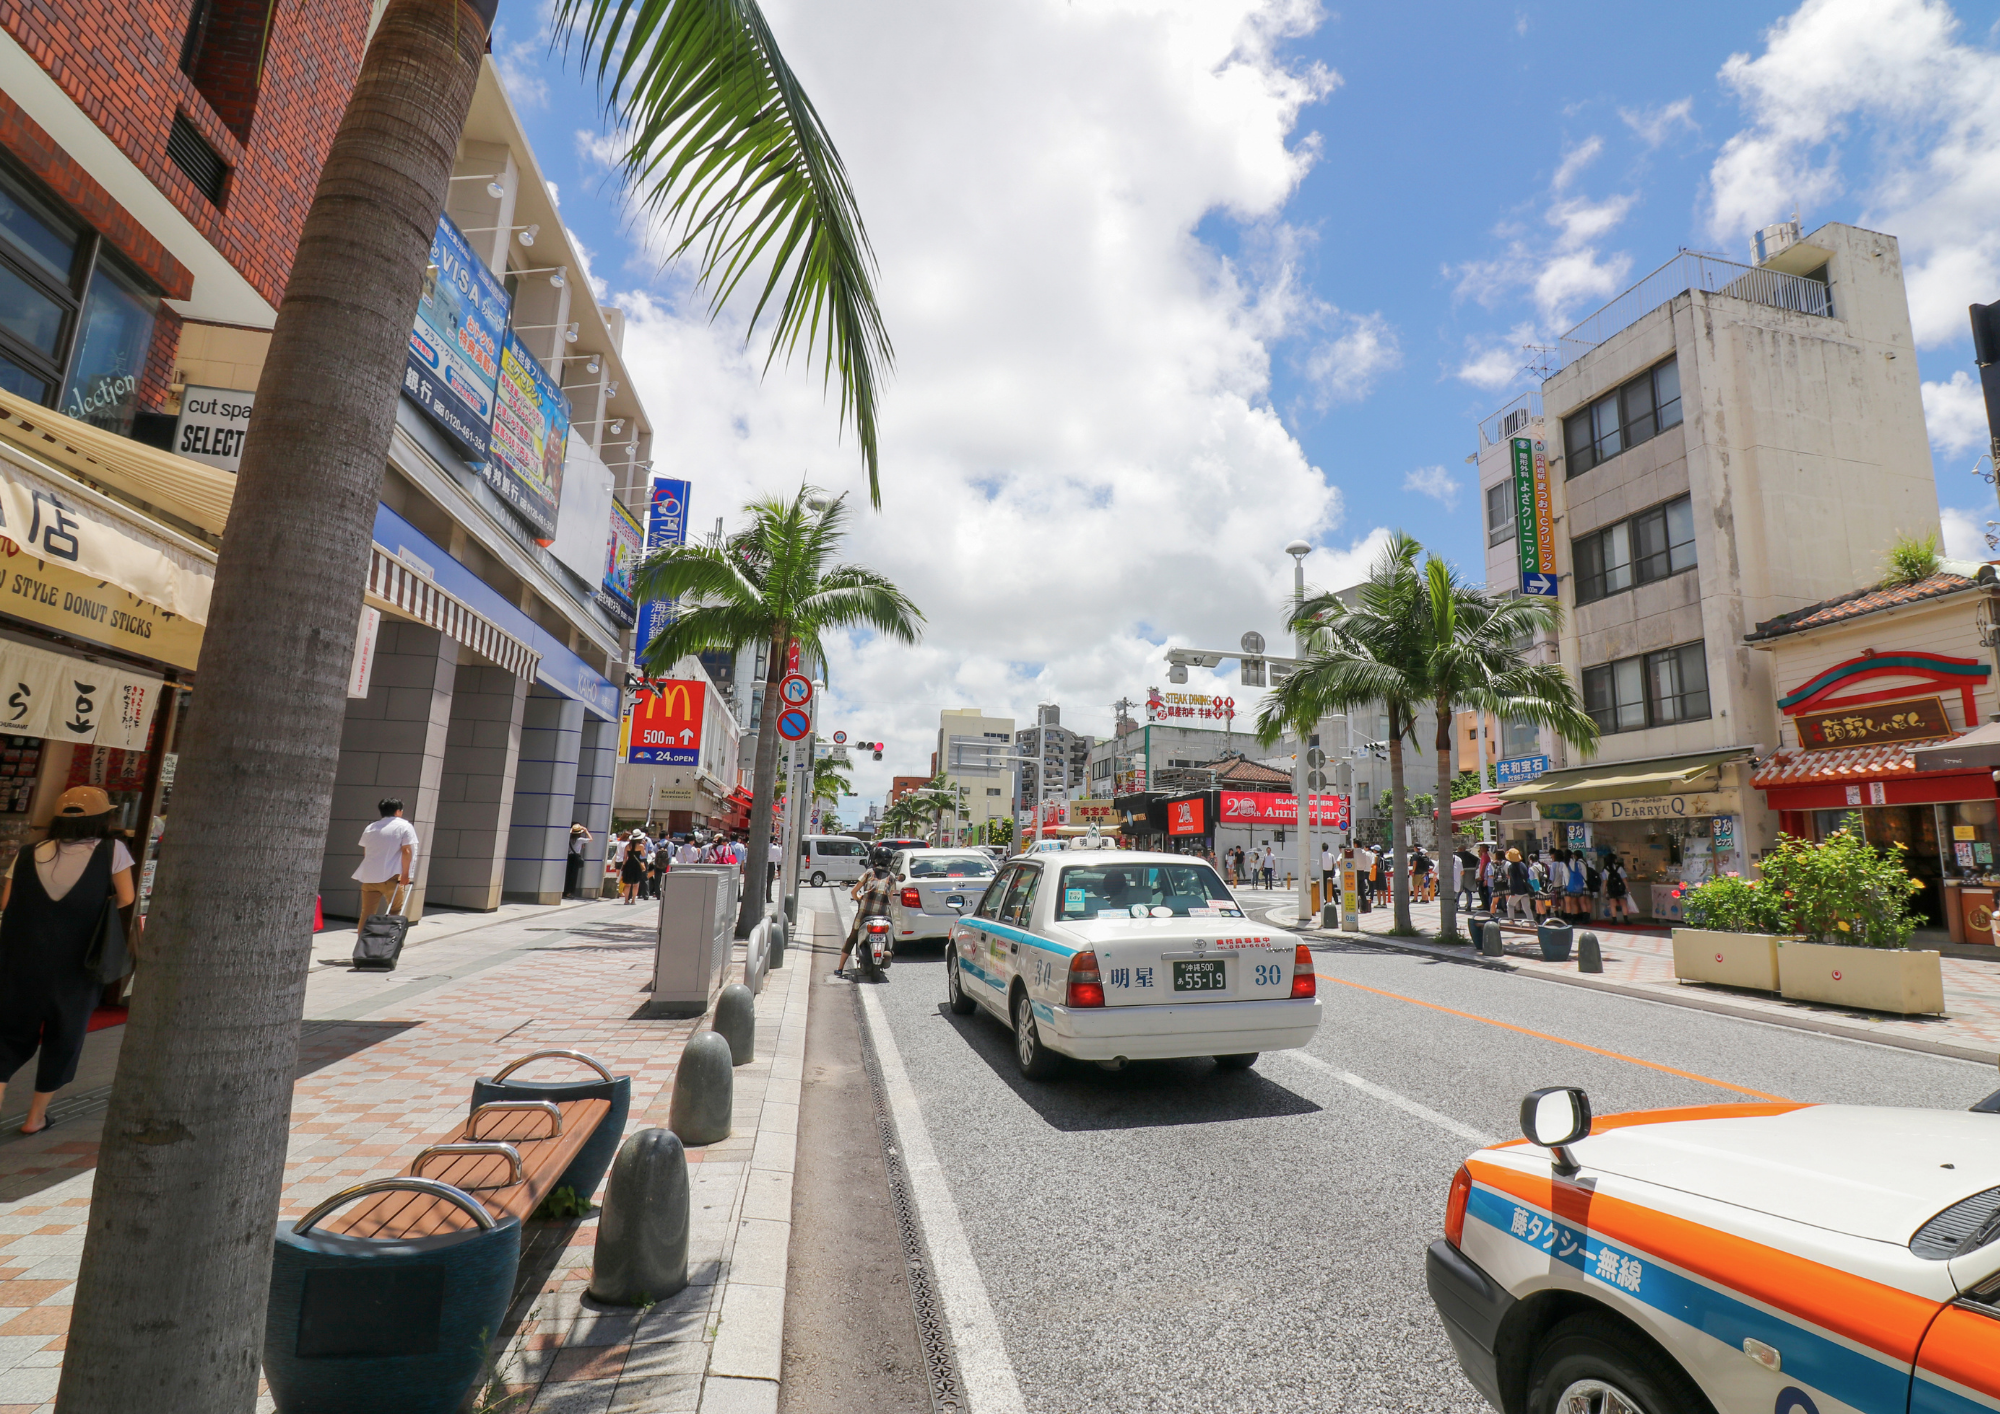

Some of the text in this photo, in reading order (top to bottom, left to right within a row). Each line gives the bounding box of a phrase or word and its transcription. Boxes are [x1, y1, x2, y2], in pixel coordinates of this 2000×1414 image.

[442, 243, 479, 310] VISA
[481, 301, 503, 331] カード
[424, 327, 466, 371] クラシックカード
[466, 315, 495, 356] おトクな
[506, 357, 544, 407] エクセレント
[510, 341, 564, 408] 無担保フリーローン
[60, 373, 136, 421] election
[188, 399, 219, 415] cut
[405, 366, 433, 405] 銀行
[444, 411, 486, 453] 0120-461-354
[180, 424, 246, 458] SELECT
[483, 460, 519, 502] 海邦銀行
[28, 488, 80, 562] 店
[493, 501, 541, 557] COMMUNITY
[1520, 480, 1535, 569] よざクリニック
[1536, 481, 1554, 572] まつおTCクリニック
[12, 573, 153, 639] STYLE DONUT STICKS
[65, 679, 97, 734] 豆
[1165, 692, 1212, 706] STEAK DINING
[643, 729, 675, 745] 500m
[673, 755, 694, 763] OPEN
[1500, 758, 1543, 775] 共和宝石
[1080, 806, 1110, 816] 東宝堂
[1713, 818, 1733, 837] 星砂
[1569, 825, 1584, 840] 星砂
[1716, 837, 1734, 847] ピアス
[1034, 958, 1052, 991] 30
[1110, 967, 1154, 989] 明星
[1185, 972, 1224, 989] 55-19
[1255, 964, 1282, 986] 30
[1510, 1206, 1643, 1293] 藤タクシー無線
